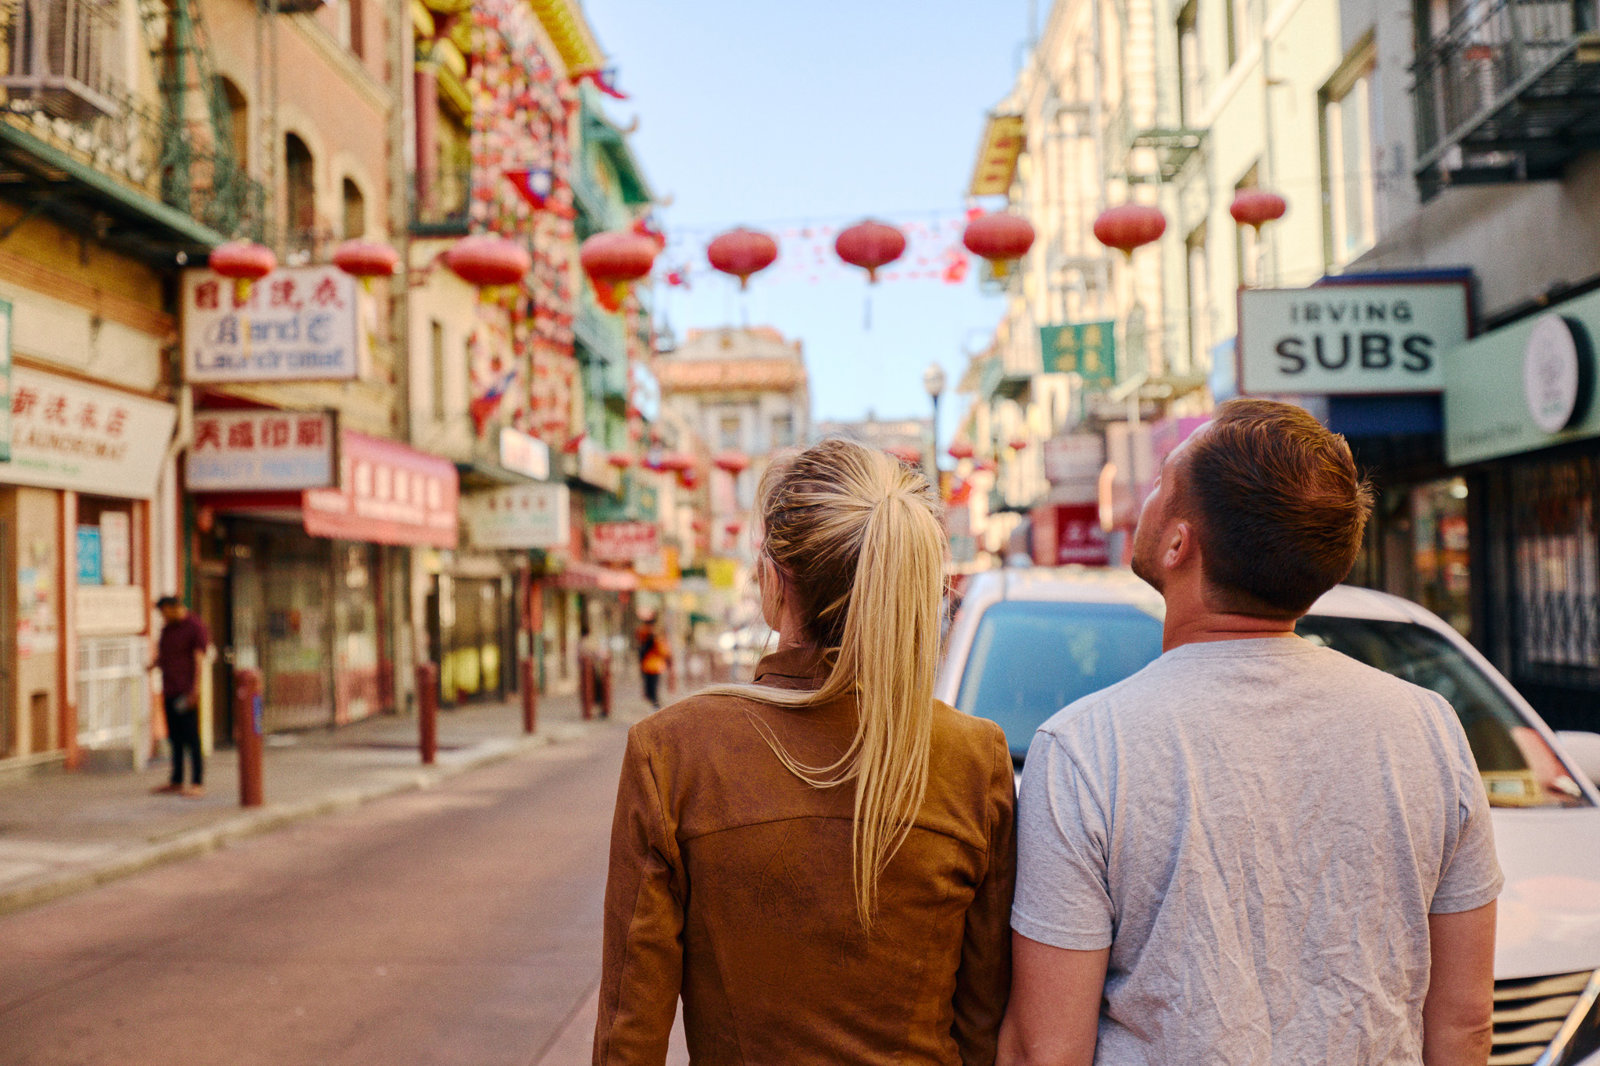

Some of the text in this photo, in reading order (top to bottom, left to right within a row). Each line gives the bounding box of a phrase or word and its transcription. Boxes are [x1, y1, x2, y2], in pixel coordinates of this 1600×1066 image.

[1291, 301, 1412, 324] IRVING
[196, 349, 344, 372] Laundromat
[1276, 334, 1434, 375] SUBS
